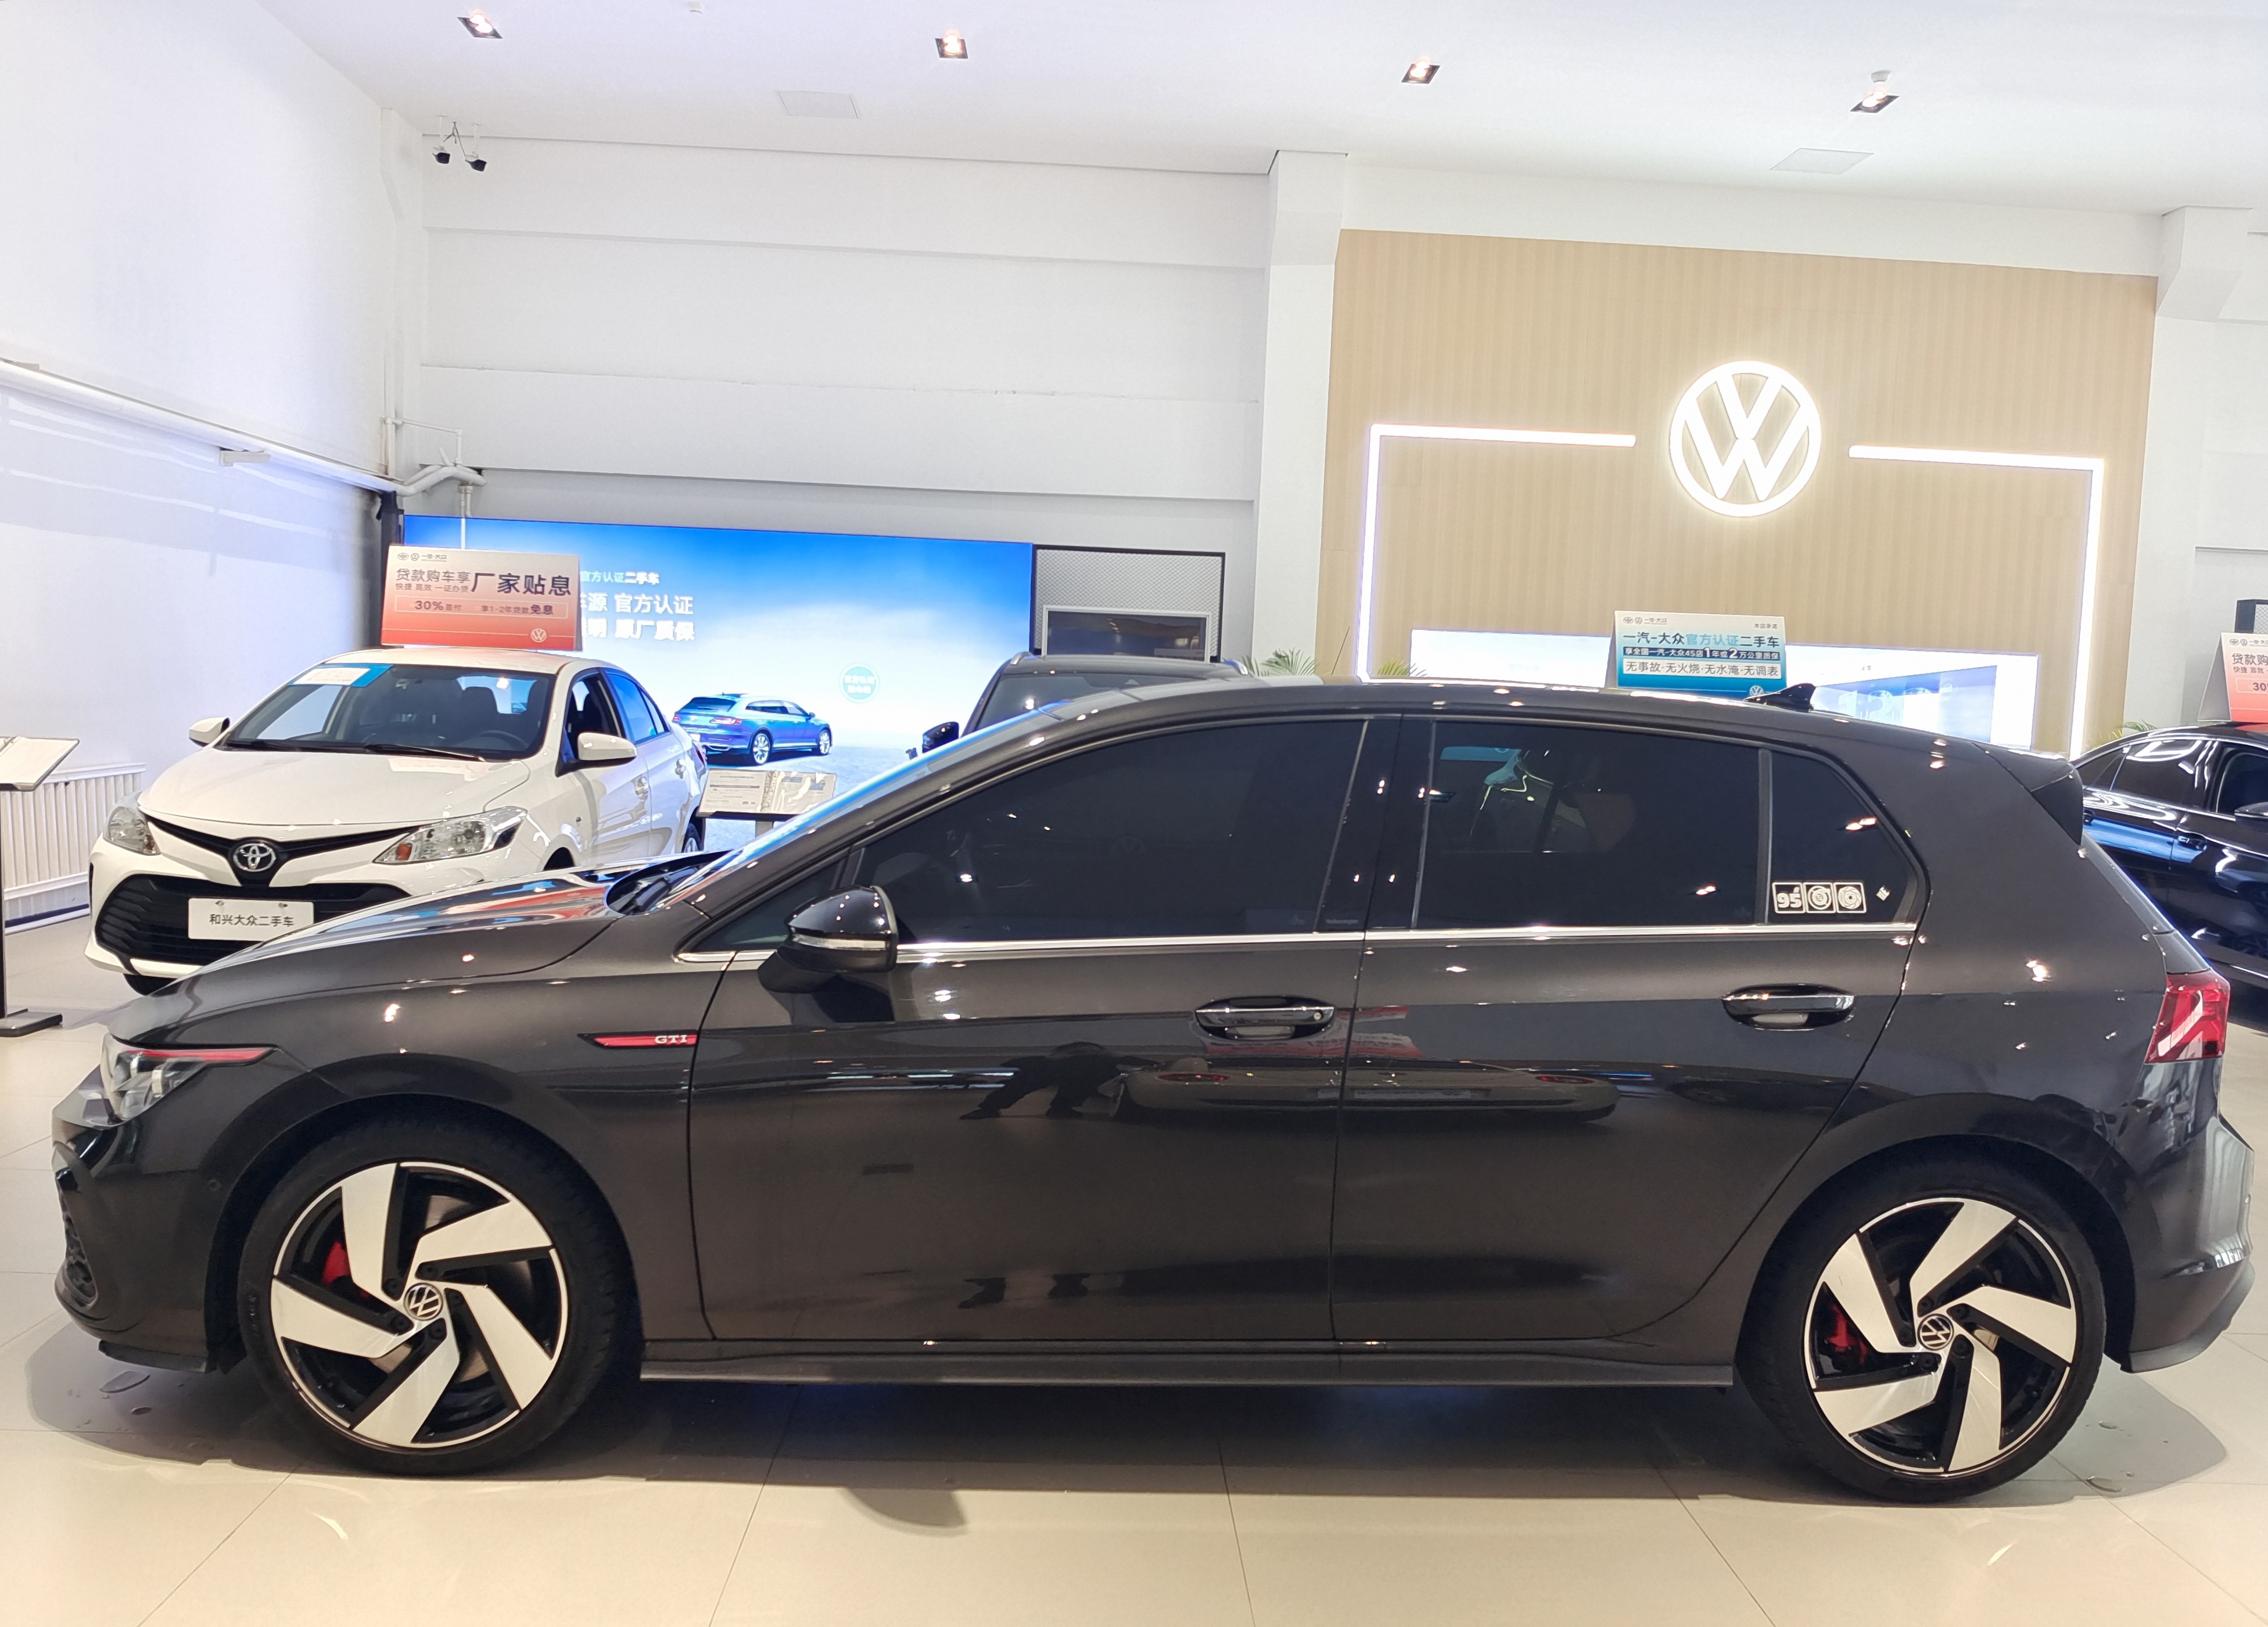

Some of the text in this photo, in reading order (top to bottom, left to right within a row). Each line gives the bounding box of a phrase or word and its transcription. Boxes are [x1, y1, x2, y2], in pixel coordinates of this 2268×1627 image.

[614, 592, 694, 615] 官方认证
[1623, 632, 1779, 648] 一汽-大众官方认证二手车
[2252, 682, 2268, 691] 30
[209, 913, 295, 927] 和兴大众二手车
[654, 1035, 688, 1044] GTI
